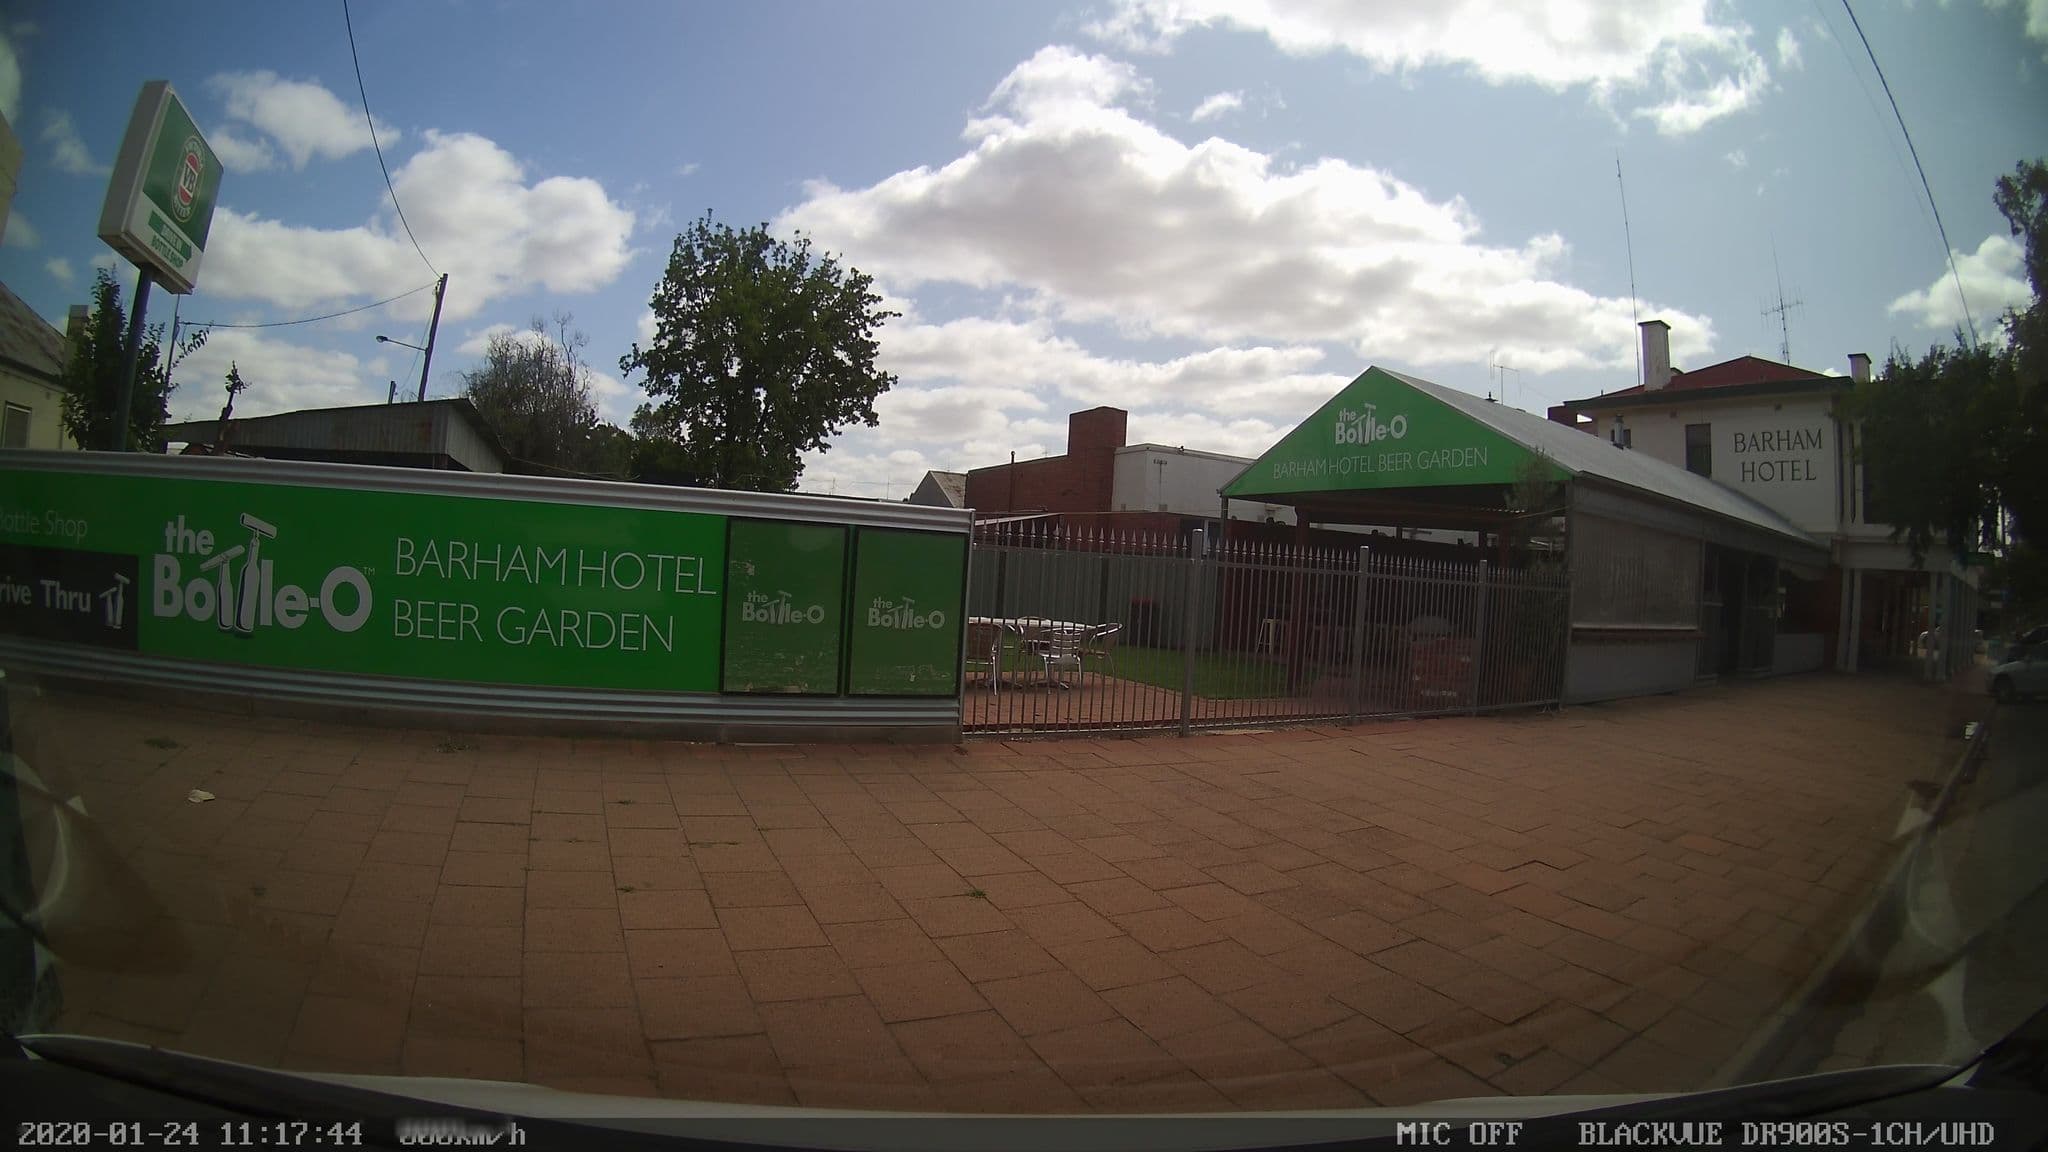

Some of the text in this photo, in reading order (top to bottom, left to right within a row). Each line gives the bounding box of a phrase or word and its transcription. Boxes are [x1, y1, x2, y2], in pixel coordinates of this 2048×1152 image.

[1335, 403, 1407, 444] Bottle-O
[1339, 408, 1356, 422] the
[1734, 428, 1823, 453] BARHAM
[1273, 447, 1488, 479] BARHAM HOTEL BEER GARDEN
[1741, 459, 1817, 482] HOTEL
[46, 509, 88, 544] Shop
[165, 515, 215, 554] the
[154, 513, 373, 633] Bottle-O
[395, 537, 717, 595] BARHAM HOTEL
[40, 579, 92, 613] Thru
[742, 590, 825, 624] Bottle-O
[747, 591, 768, 603] the
[867, 596, 946, 629] Bottle-O
[873, 597, 892, 609] the
[394, 599, 674, 652] BEER GARDEN
